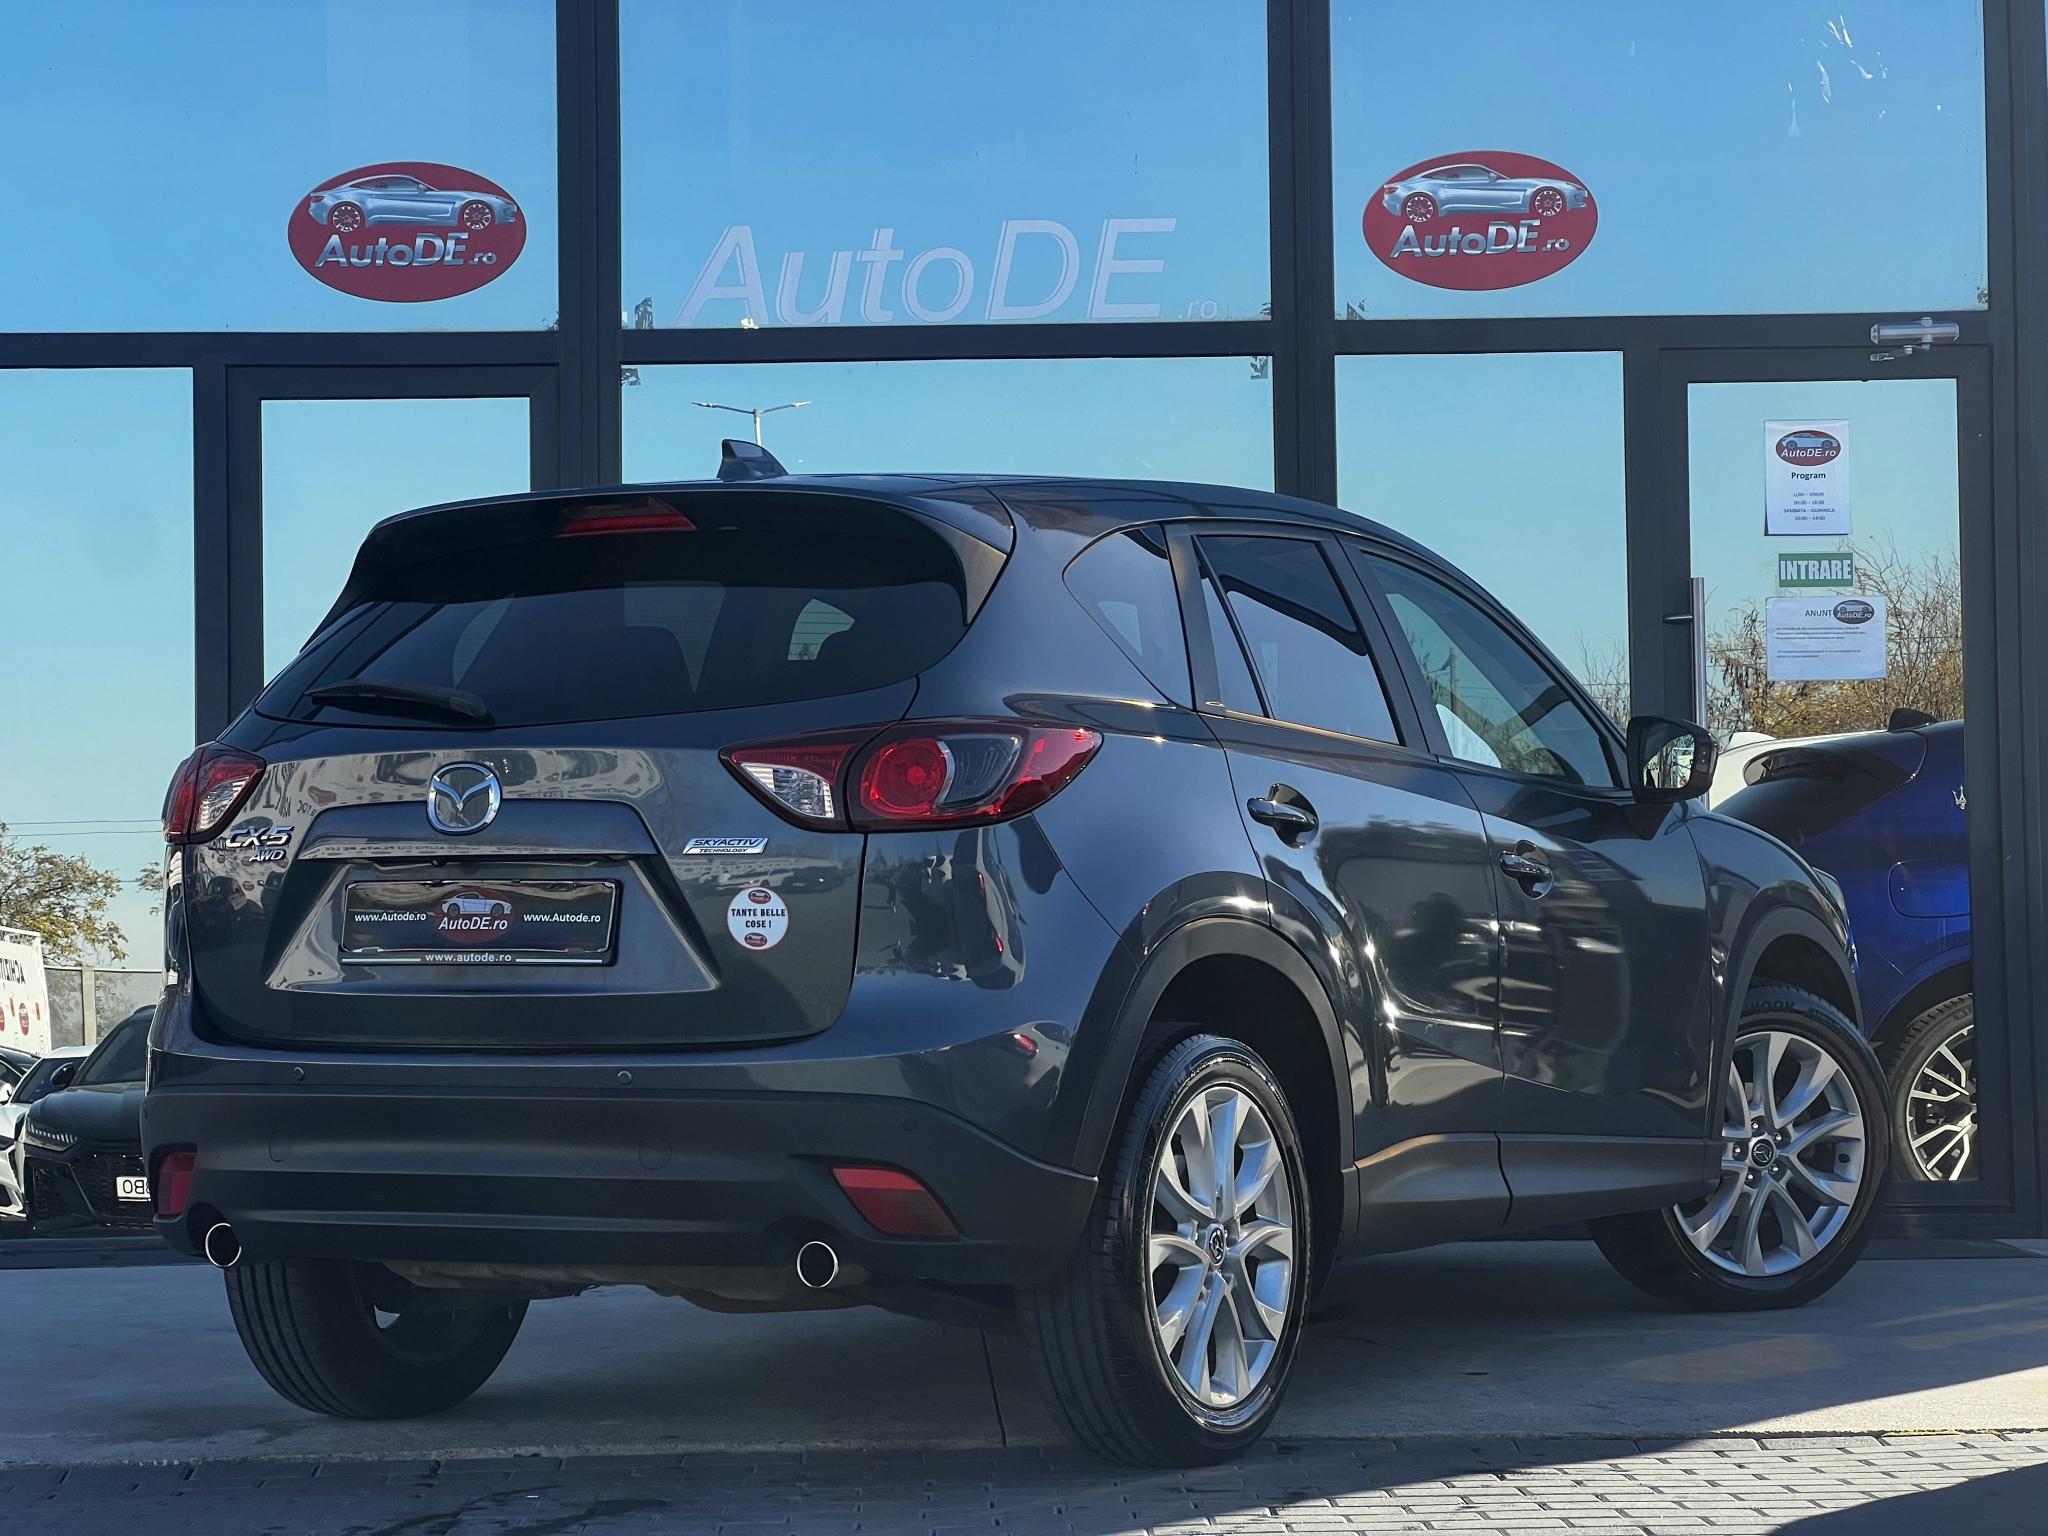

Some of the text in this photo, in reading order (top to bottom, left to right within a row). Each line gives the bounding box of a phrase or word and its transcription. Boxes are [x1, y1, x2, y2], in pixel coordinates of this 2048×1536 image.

[1781, 448, 1836, 458] AutoDE.ro
[1791, 472, 1826, 480] Program
[1780, 560, 1851, 580] INTRARE
[226, 826, 295, 848] CX-5
[249, 849, 285, 862] AWD
[354, 911, 427, 922] www.Autode.ro
[523, 912, 601, 923] www.Autode.ro
[731, 908, 786, 917] TANTE BELLE
[438, 916, 508, 930] AutoDE.ro
[745, 920, 766, 928] COSE
[425, 952, 512, 963] www.autode.ro
